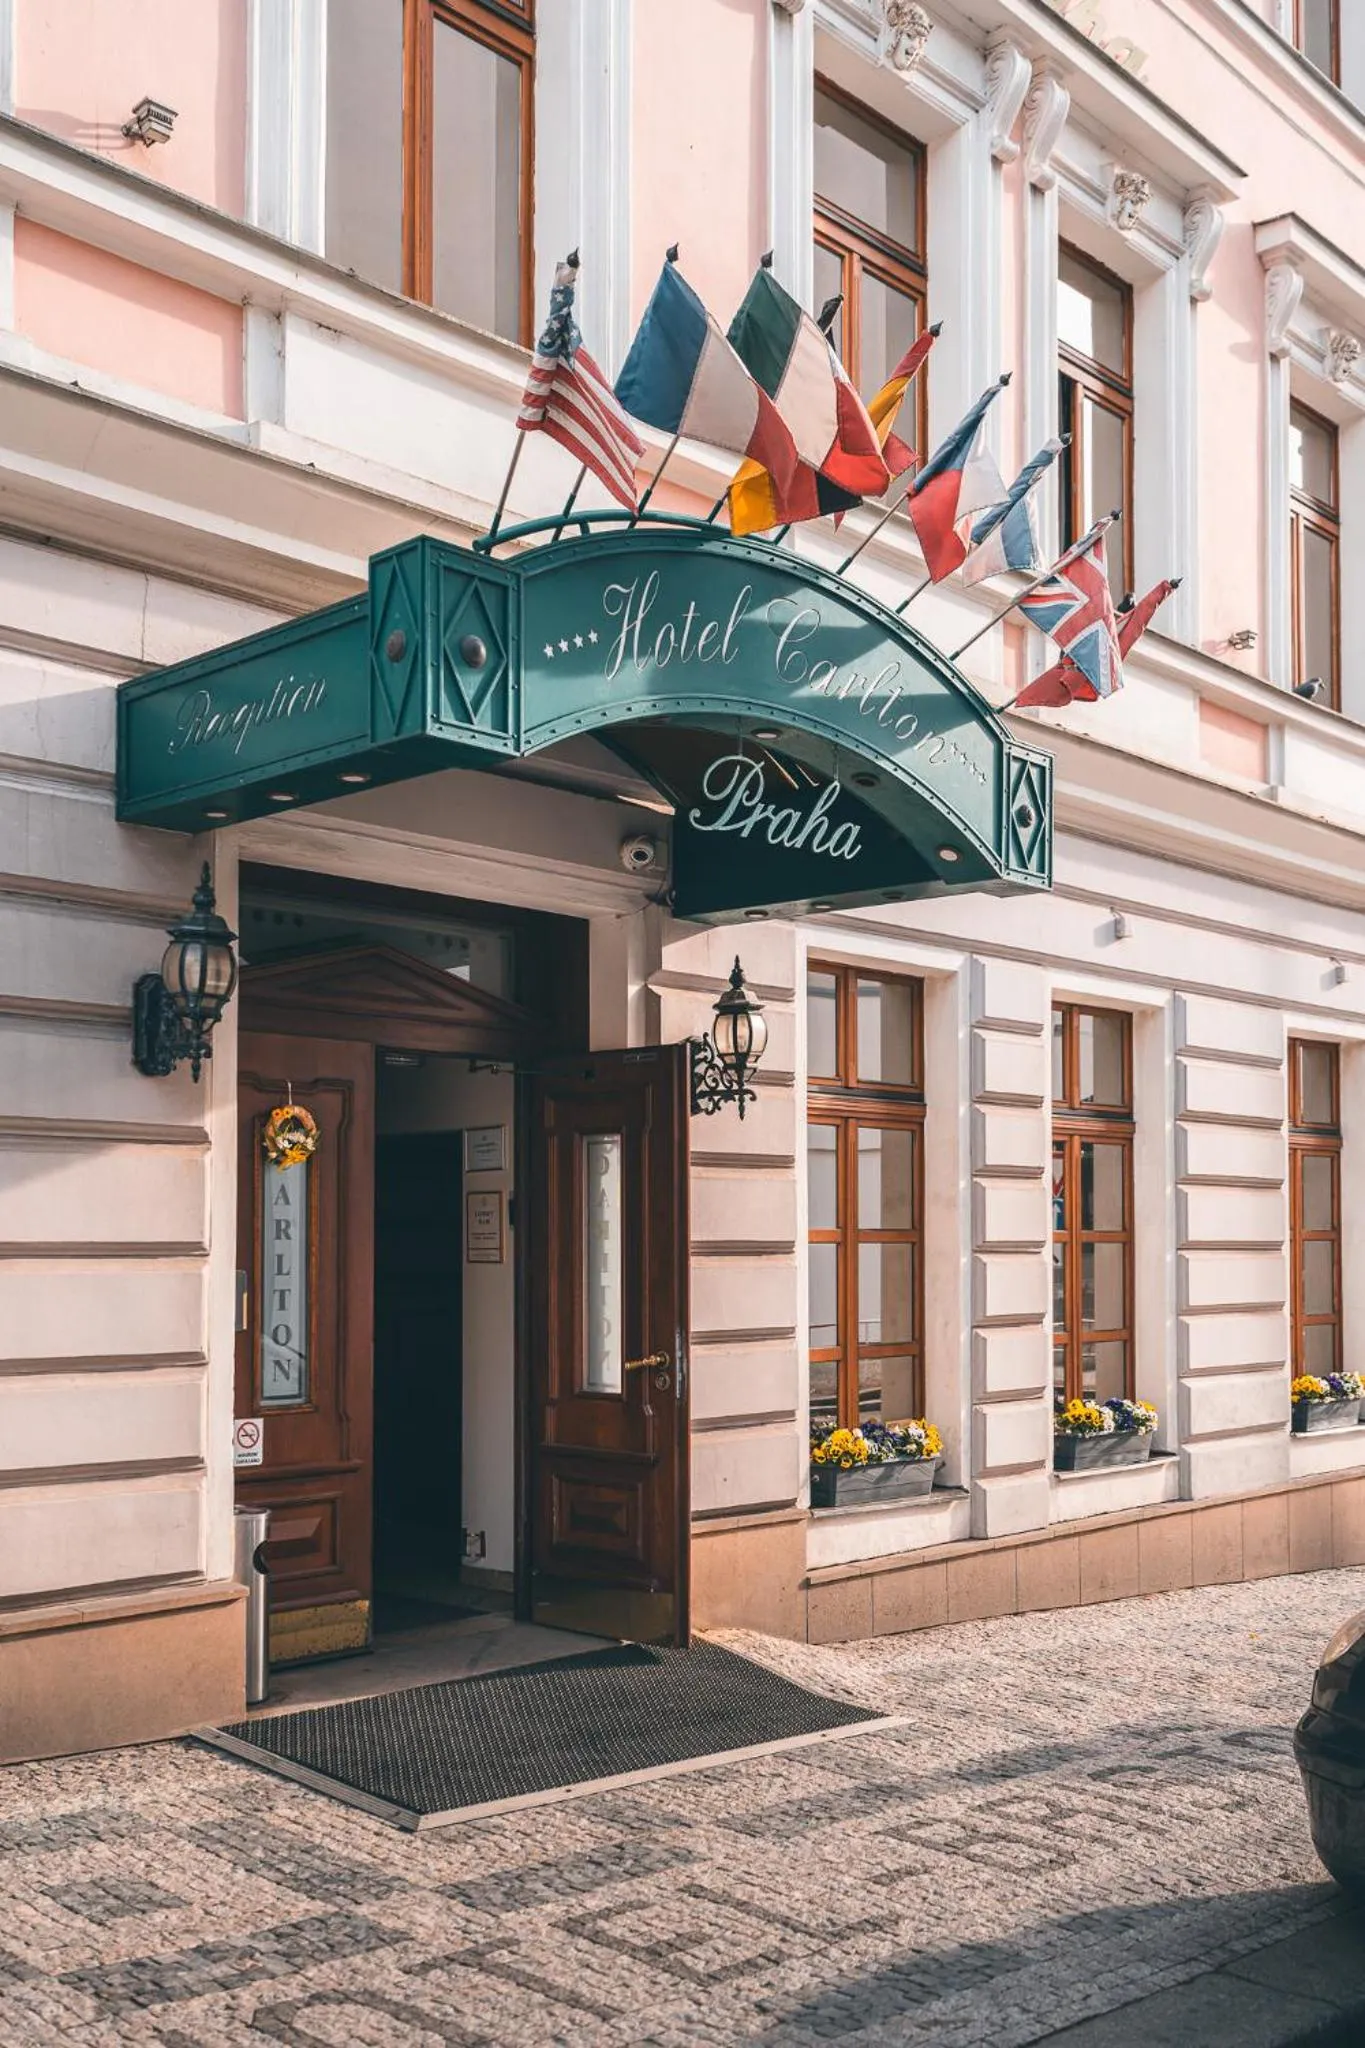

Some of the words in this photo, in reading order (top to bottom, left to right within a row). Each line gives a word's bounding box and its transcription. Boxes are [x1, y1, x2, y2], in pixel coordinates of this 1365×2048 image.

[167, 675, 327, 755] Reception
[603, 570, 752, 681] Hotel
[766, 597, 951, 765] Carlton
[689, 754, 862, 860] Praha
[272, 1166, 293, 1383] ARLTON
